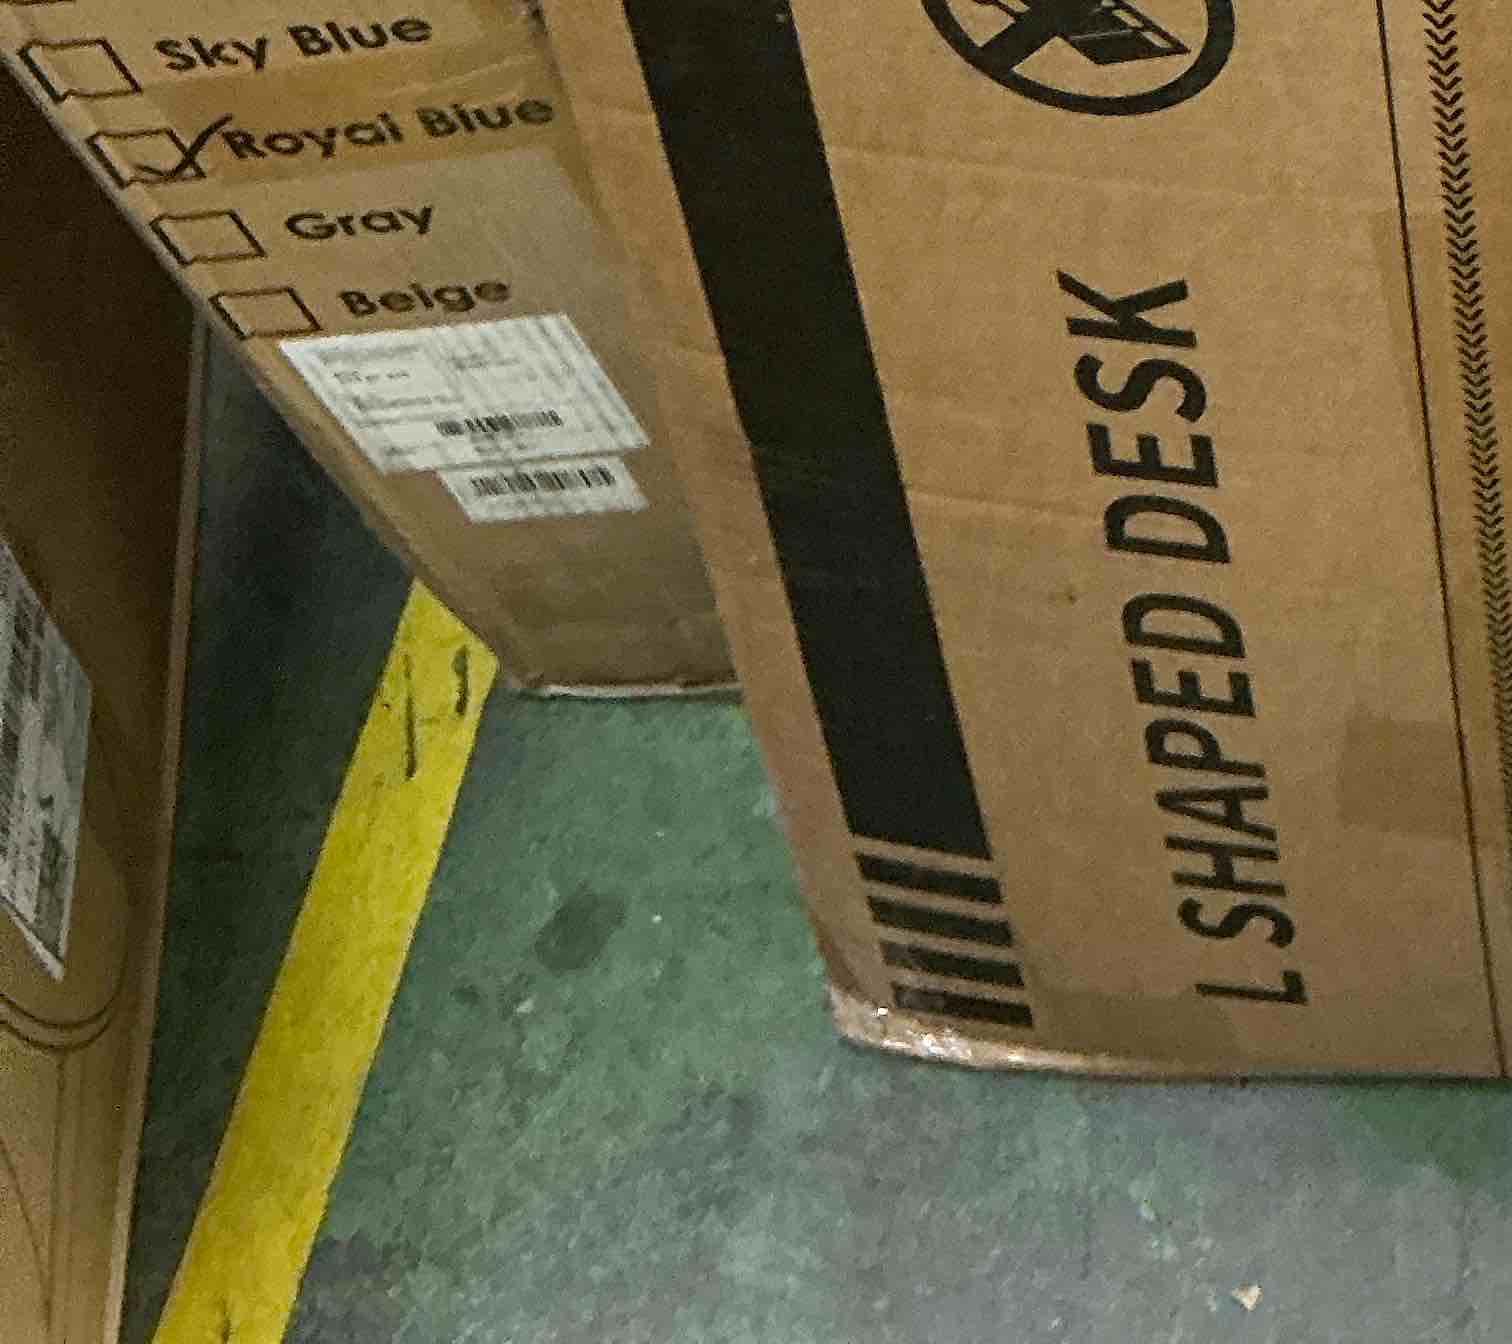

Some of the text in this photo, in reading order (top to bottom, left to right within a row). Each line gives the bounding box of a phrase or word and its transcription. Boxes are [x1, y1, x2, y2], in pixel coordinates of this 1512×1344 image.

[154, 15, 433, 74] Sky Blue
[222, 95, 556, 161] Royal Blue
[284, 202, 435, 243] Gray
[338, 279, 513, 317] Beige
[1055, 266, 1309, 1005] L SHAPED DESK
